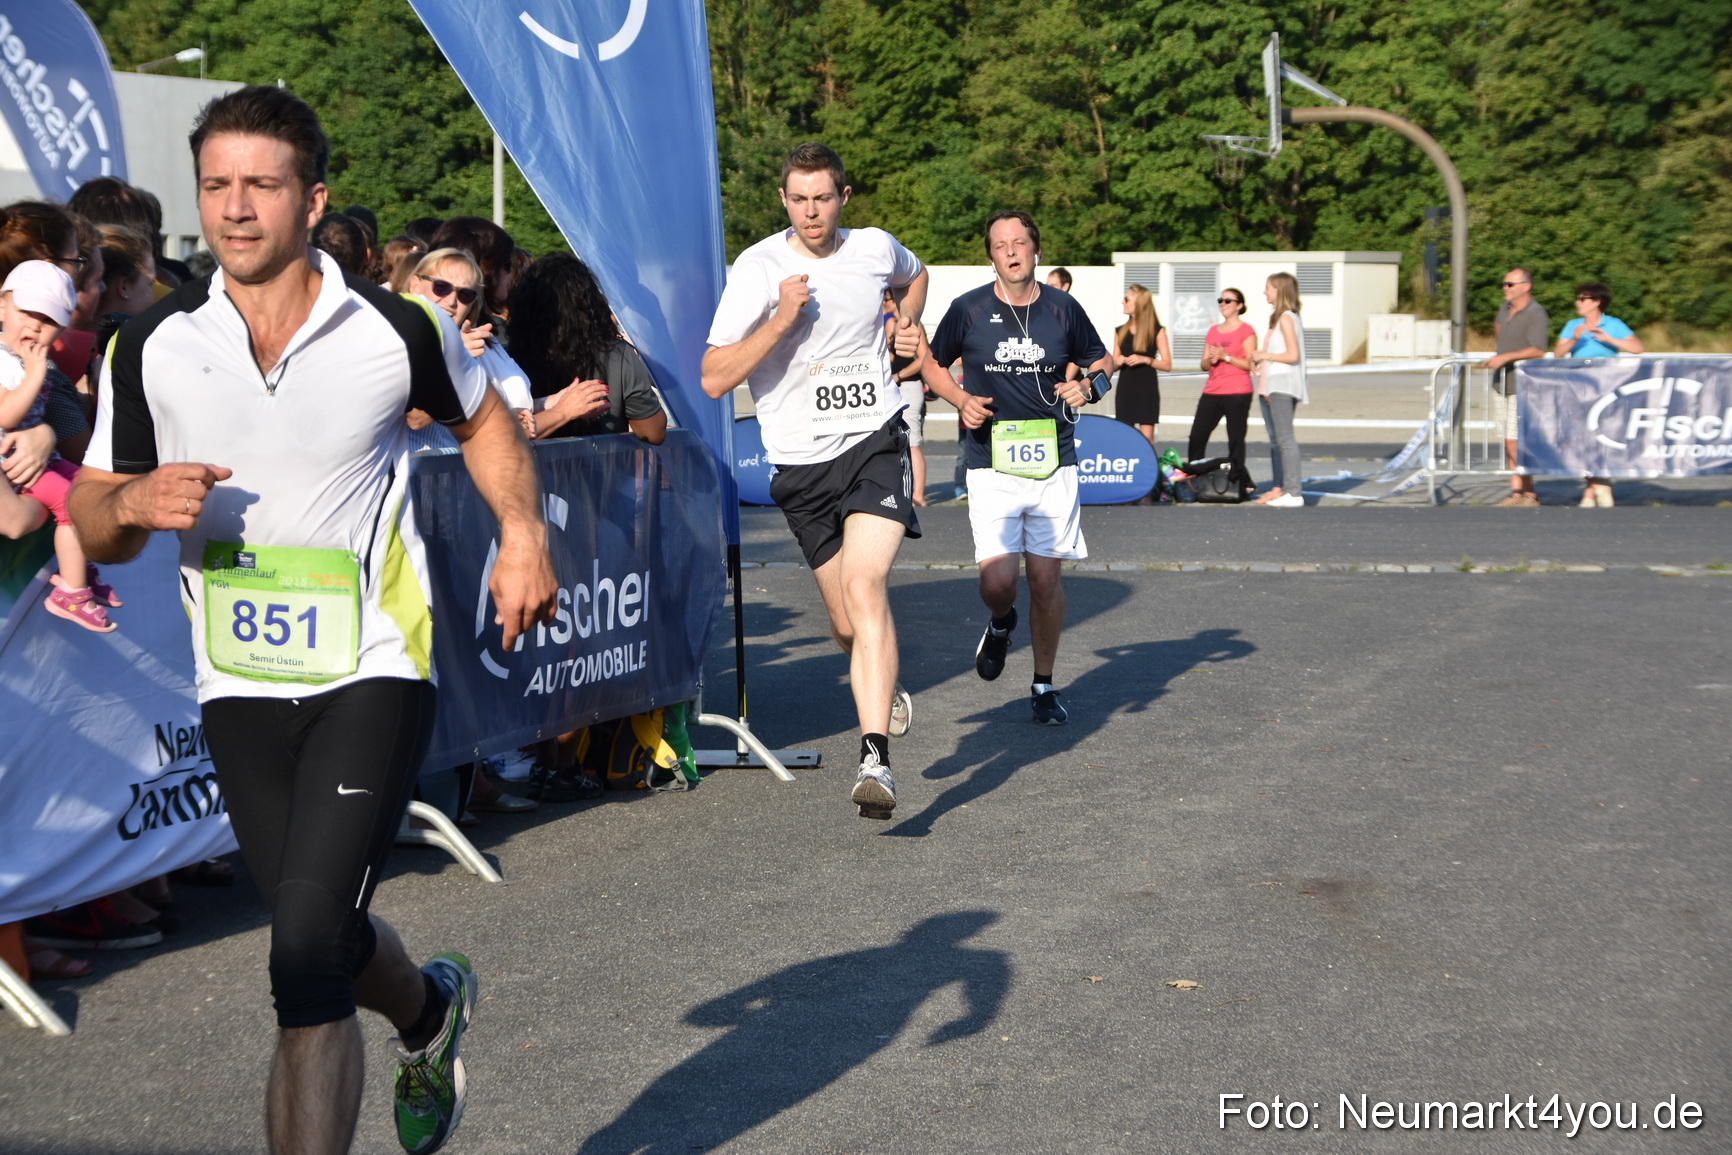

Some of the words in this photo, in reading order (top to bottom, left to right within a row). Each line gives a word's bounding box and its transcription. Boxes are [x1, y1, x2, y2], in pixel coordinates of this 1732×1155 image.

[809, 362, 871, 377] df-sports
[984, 363, 1012, 372] Weil's
[816, 382, 877, 411] 8933
[812, 411, 883, 422] www.df-sports.de
[1007, 444, 1046, 463] 165
[1077, 453, 1140, 473] cher
[1077, 474, 1134, 484] OMOBILE
[232, 599, 317, 649] 851
[249, 653, 276, 664] Semir
[276, 655, 304, 667] Üstün
[523, 640, 647, 698] AUTOMOBILE
